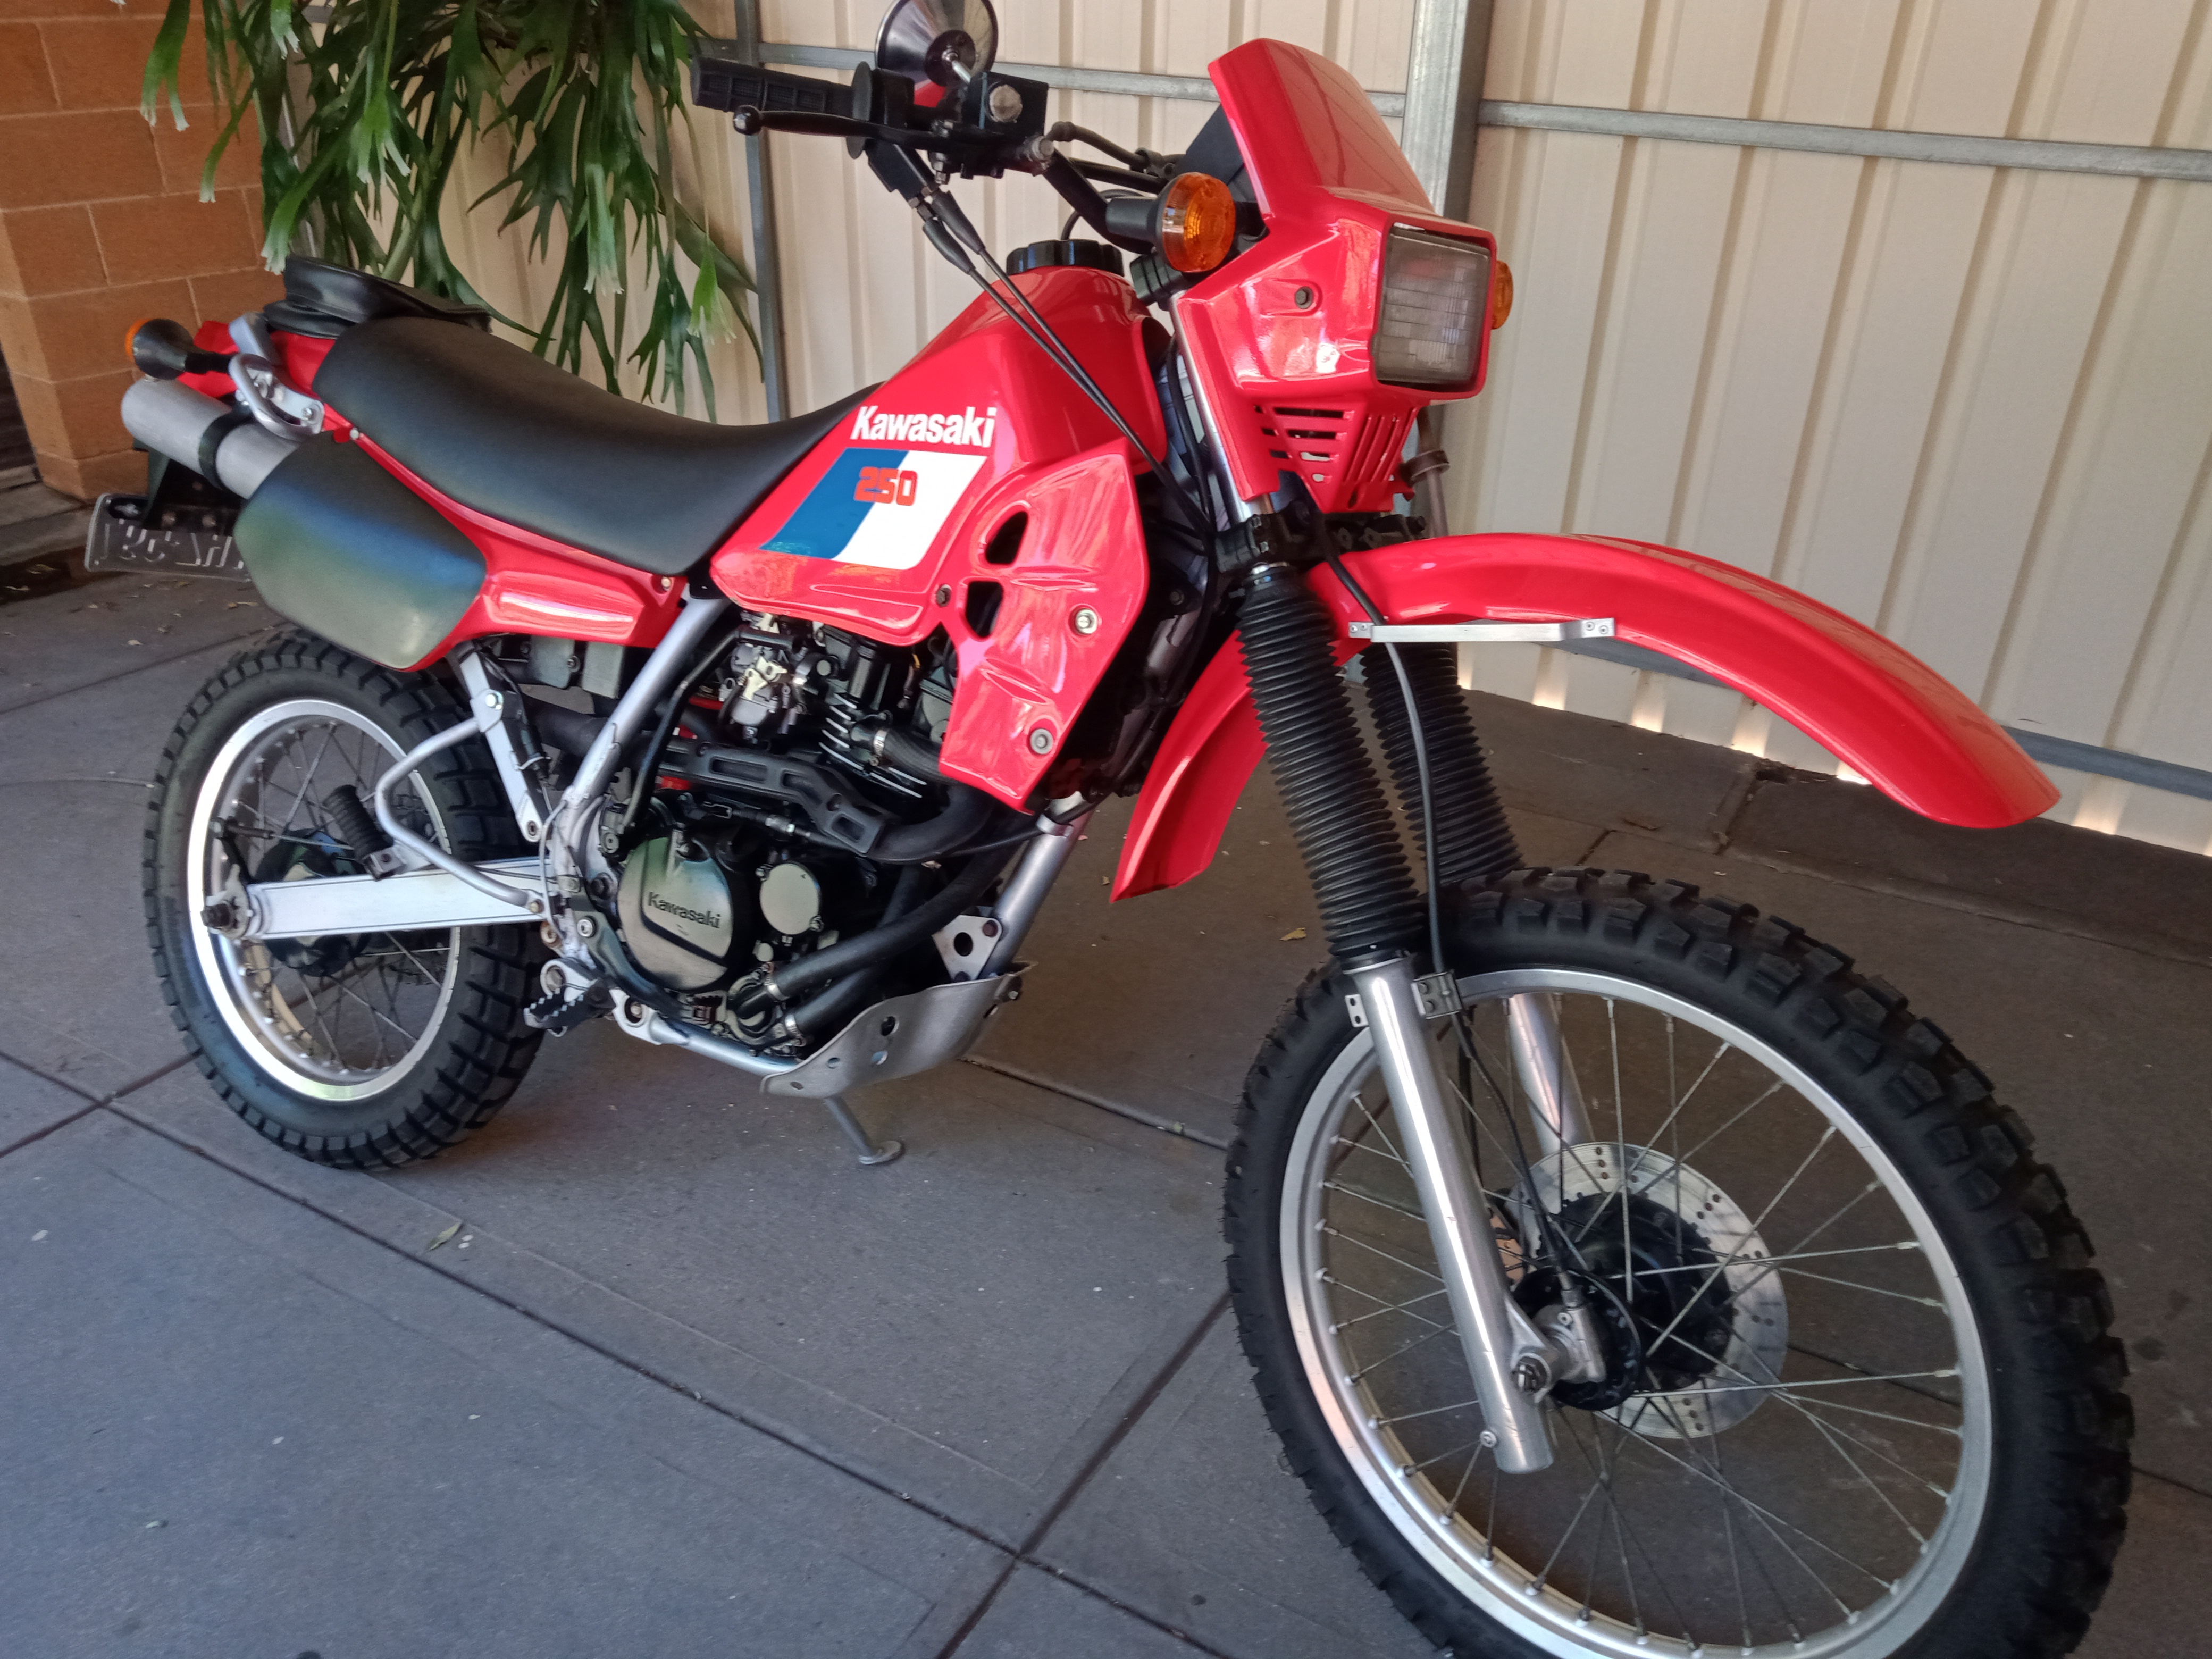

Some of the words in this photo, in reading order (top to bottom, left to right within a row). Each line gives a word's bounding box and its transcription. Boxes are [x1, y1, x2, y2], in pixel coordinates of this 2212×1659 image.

[850, 405, 997, 447] Kawasaki
[853, 466, 918, 506] 250
[648, 891, 721, 929] Kawasaki
